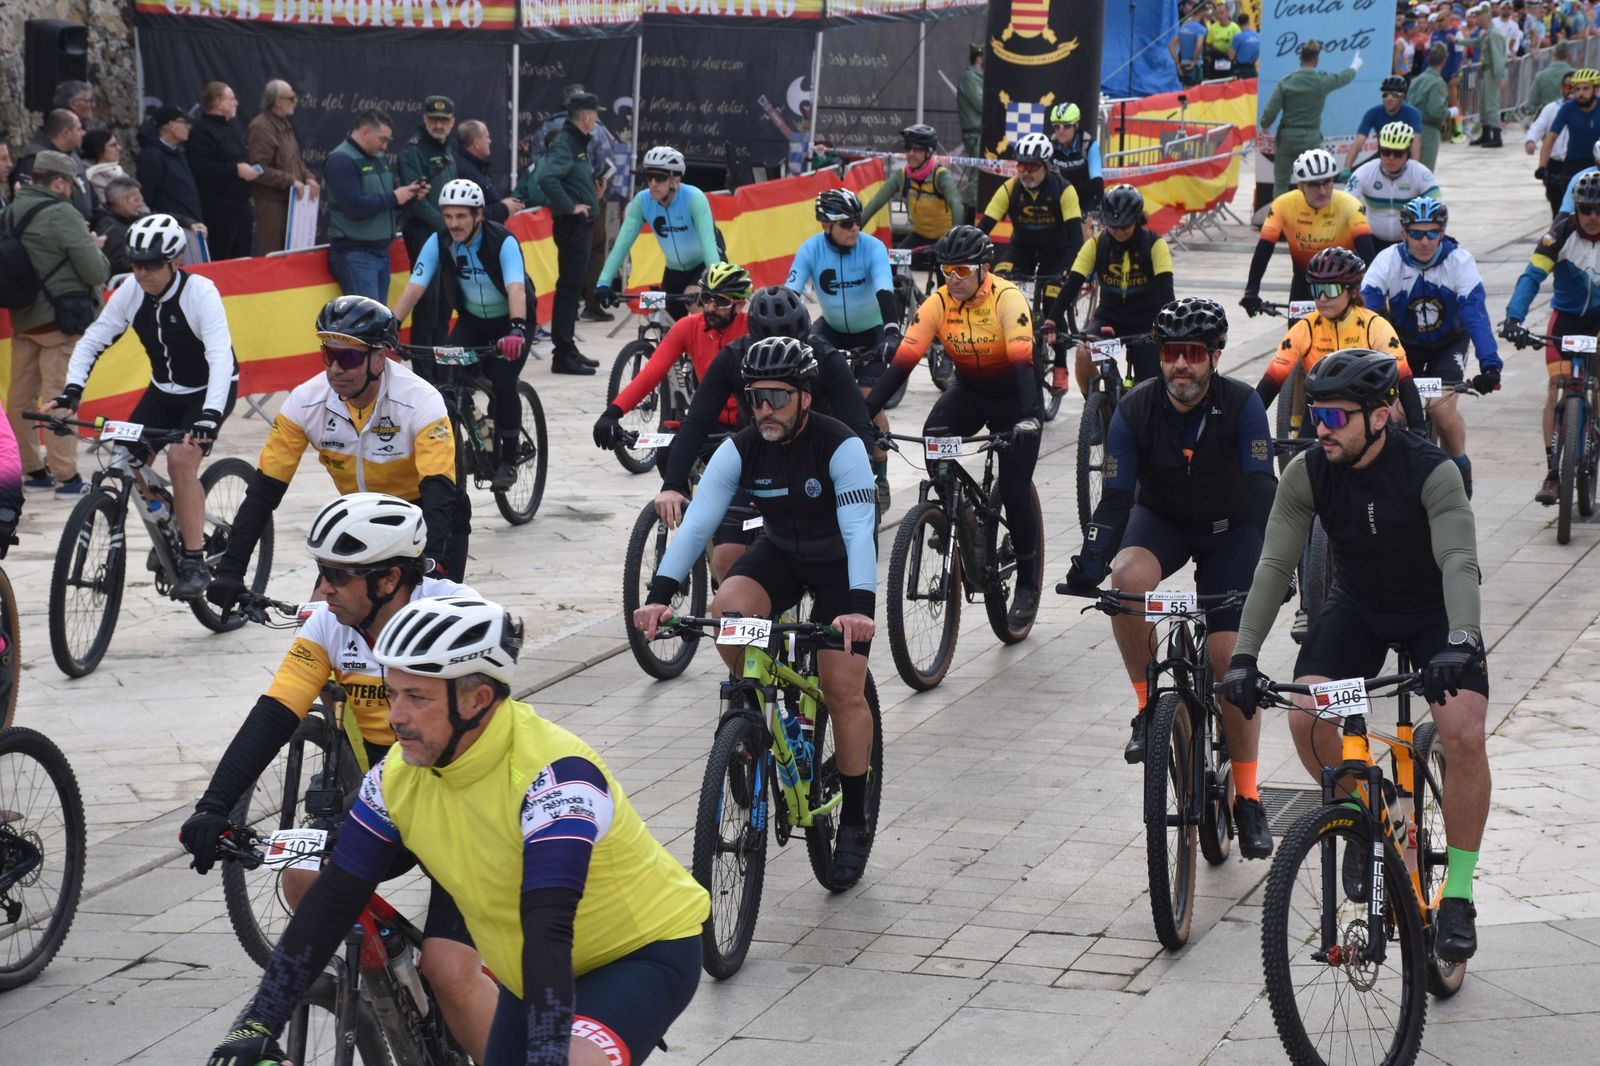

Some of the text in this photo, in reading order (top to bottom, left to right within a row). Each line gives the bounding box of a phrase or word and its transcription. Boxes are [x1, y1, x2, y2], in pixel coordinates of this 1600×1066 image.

[1275, 28, 1376, 57] Deorte
[117, 426, 138, 436] 214
[940, 443, 959, 454] 221
[1170, 601, 1188, 614] 55
[740, 625, 765, 639] 146
[448, 646, 495, 665] SCOTT
[1333, 688, 1362, 706] 106
[289, 840, 320, 856] 107
